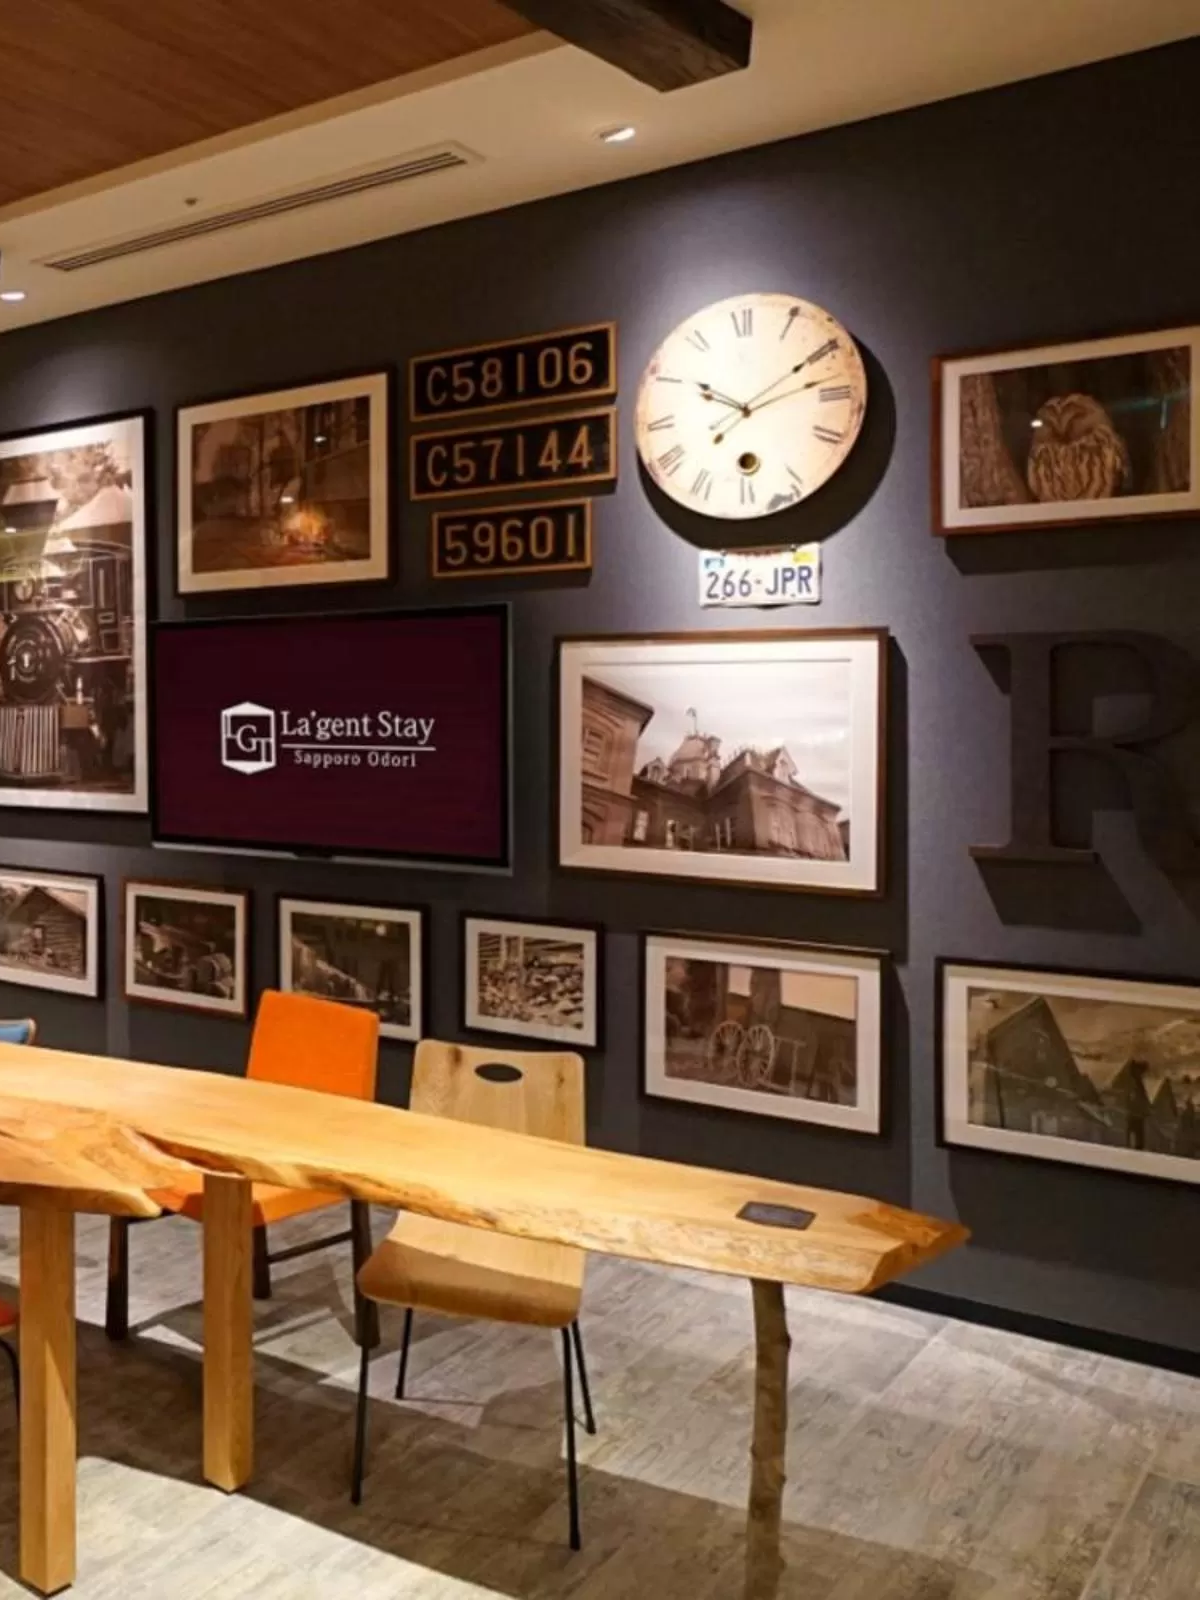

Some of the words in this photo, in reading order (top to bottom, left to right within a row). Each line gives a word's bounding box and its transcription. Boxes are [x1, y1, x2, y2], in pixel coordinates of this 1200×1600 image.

[427, 341, 593, 406] C58106
[427, 424, 593, 487] C57144
[445, 513, 576, 565] 59601
[280, 709, 372, 741] La'gent
[377, 710, 435, 745] Stay
[294, 750, 361, 769] Sapporo
[367, 751, 416, 768] Odori
